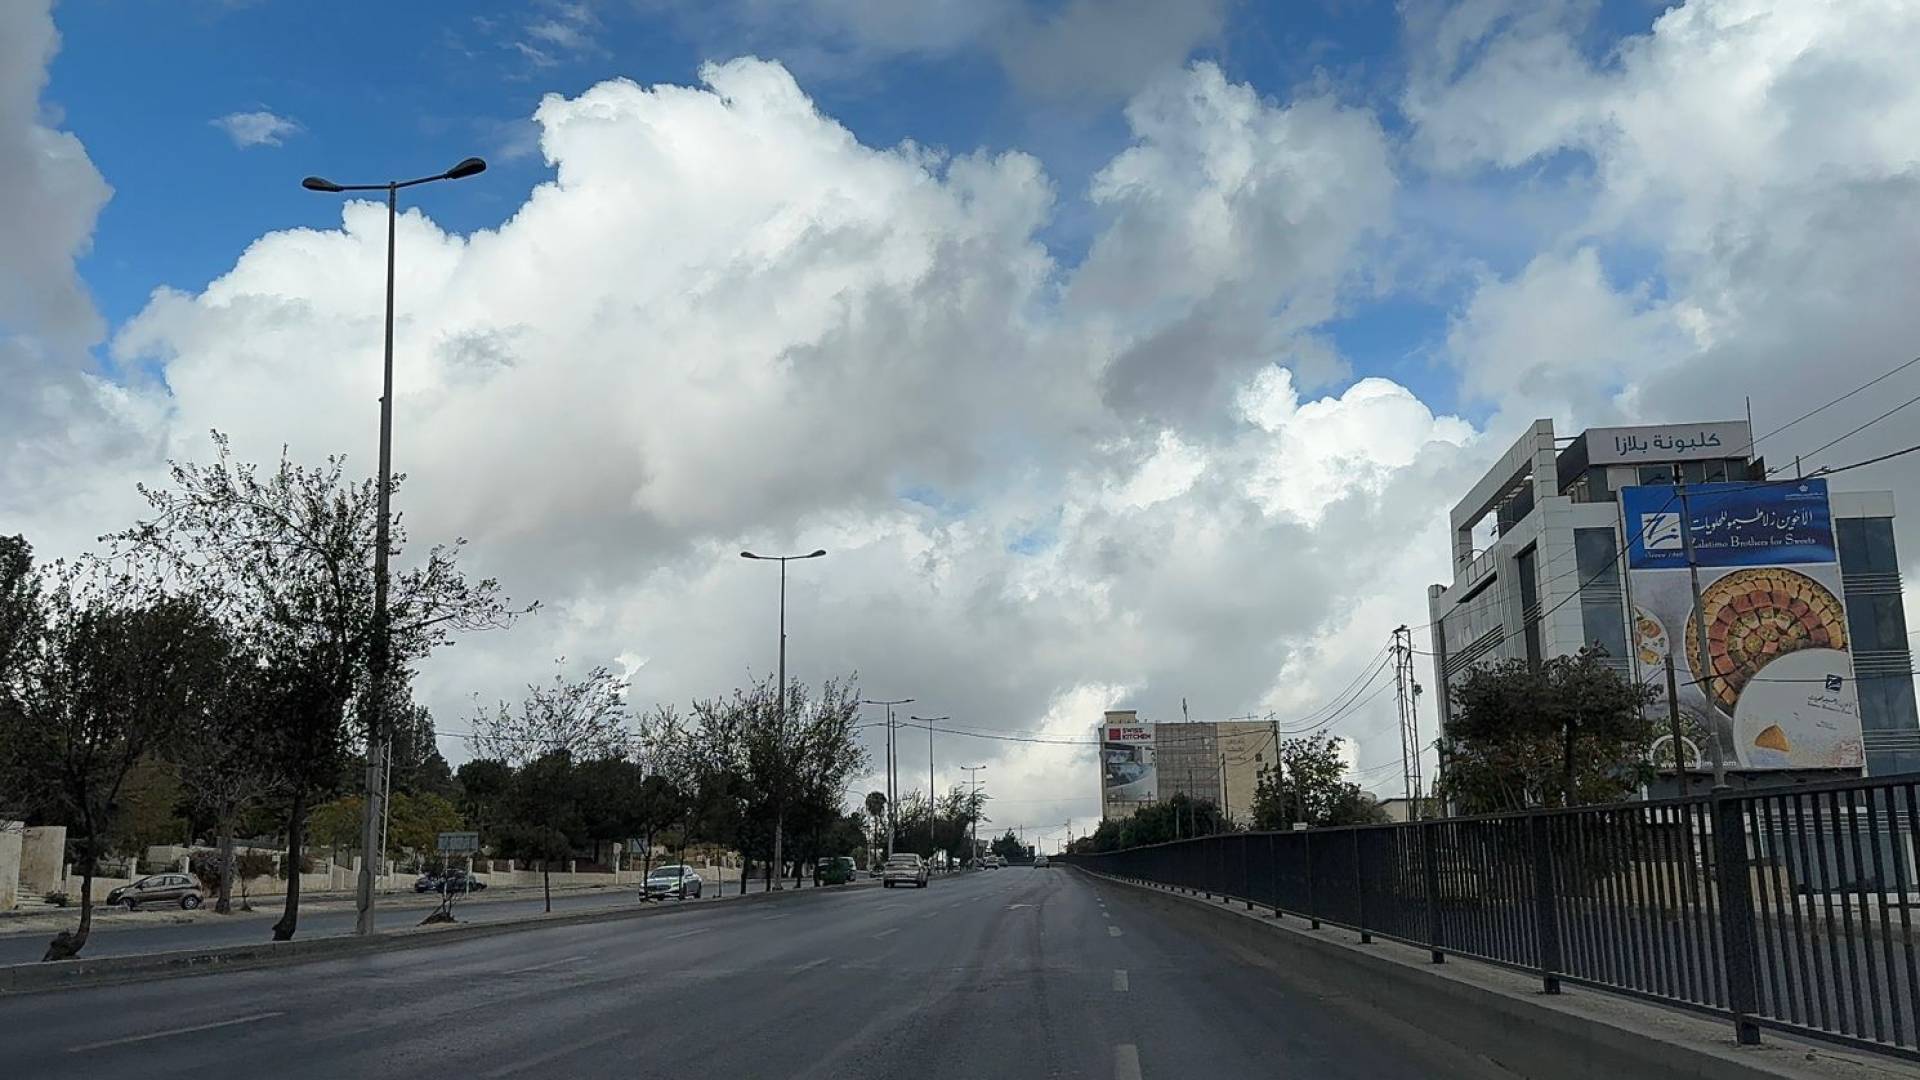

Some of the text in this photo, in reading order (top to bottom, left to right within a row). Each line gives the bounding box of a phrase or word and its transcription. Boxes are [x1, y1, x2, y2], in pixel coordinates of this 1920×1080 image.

[1615, 431, 1721, 456] كلبونة بلازا
[1731, 535, 1769, 548] Brothers
[1770, 535, 1782, 546] for
[1785, 533, 1817, 545] Sweets
